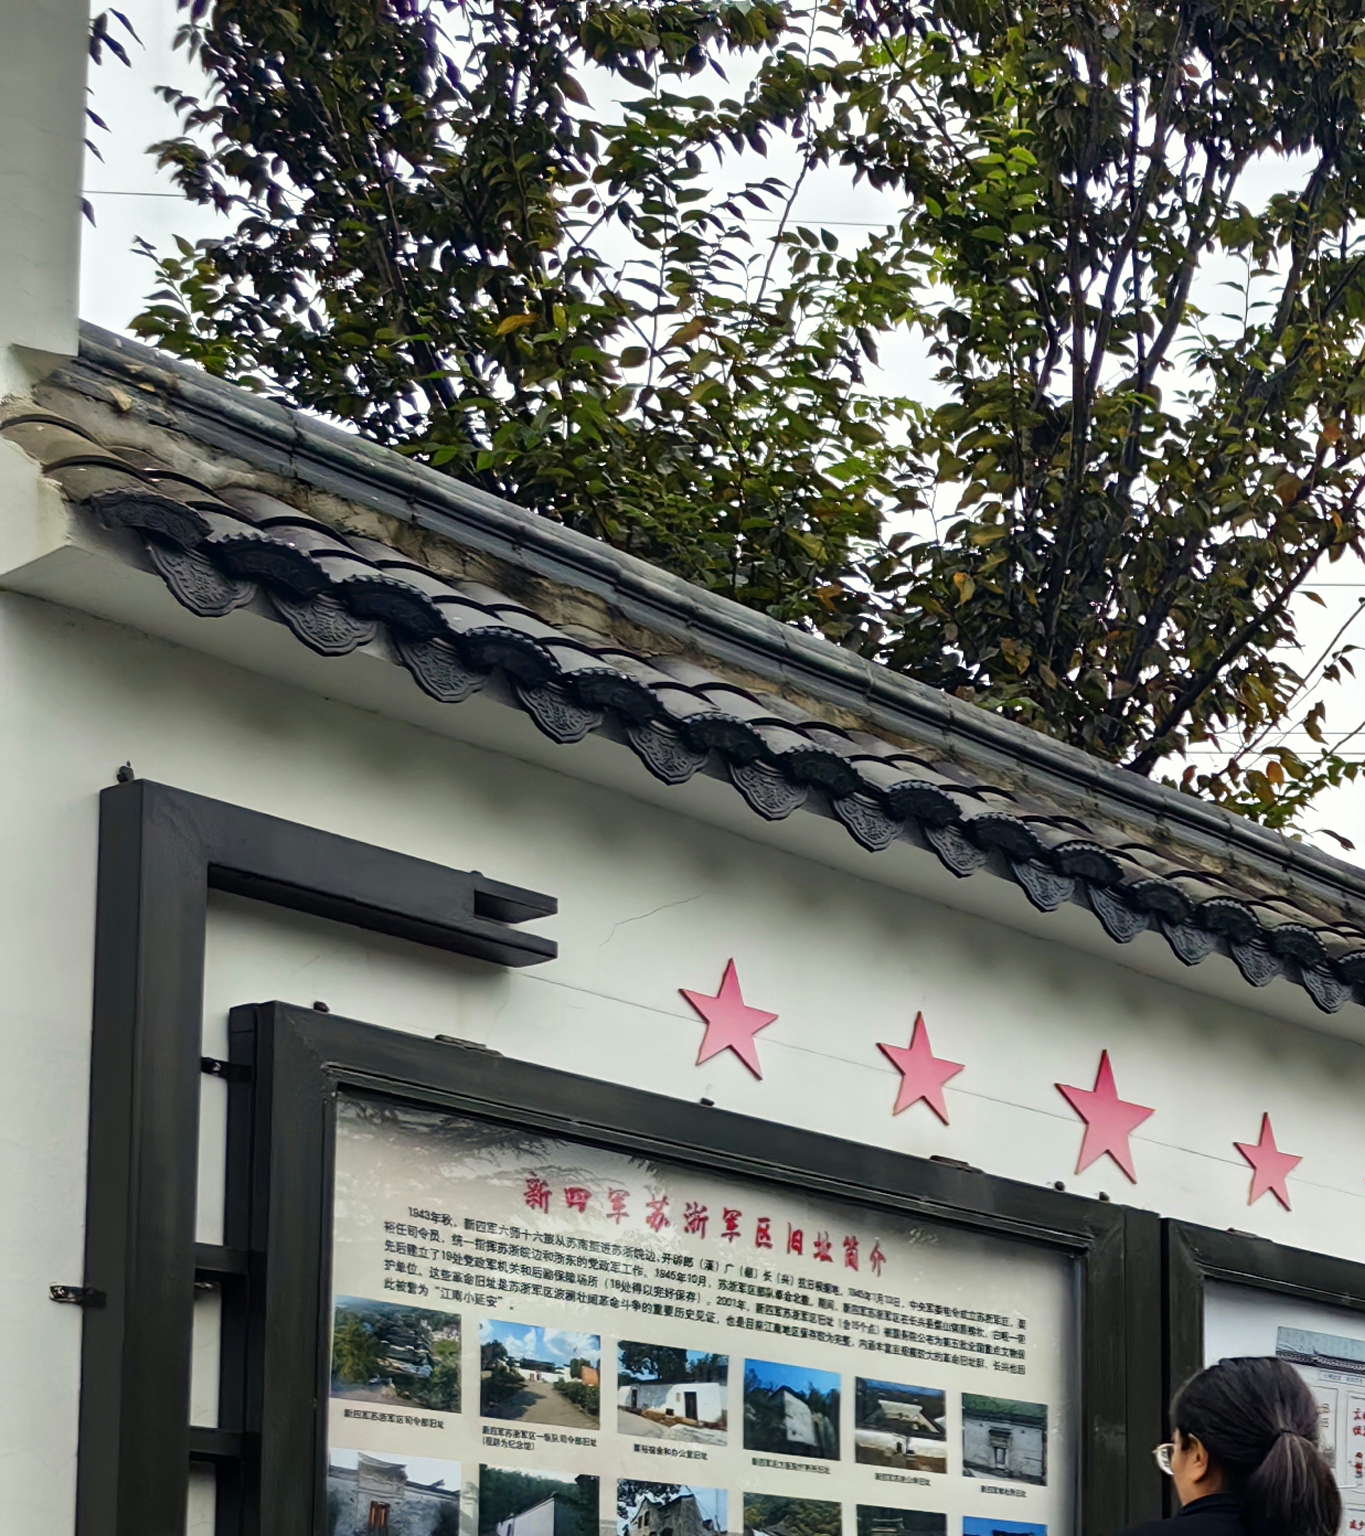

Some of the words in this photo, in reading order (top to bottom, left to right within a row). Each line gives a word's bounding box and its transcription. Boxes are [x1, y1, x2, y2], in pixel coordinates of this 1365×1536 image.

[523, 1171, 886, 1278] 新四军苏浙军区旧址简介
